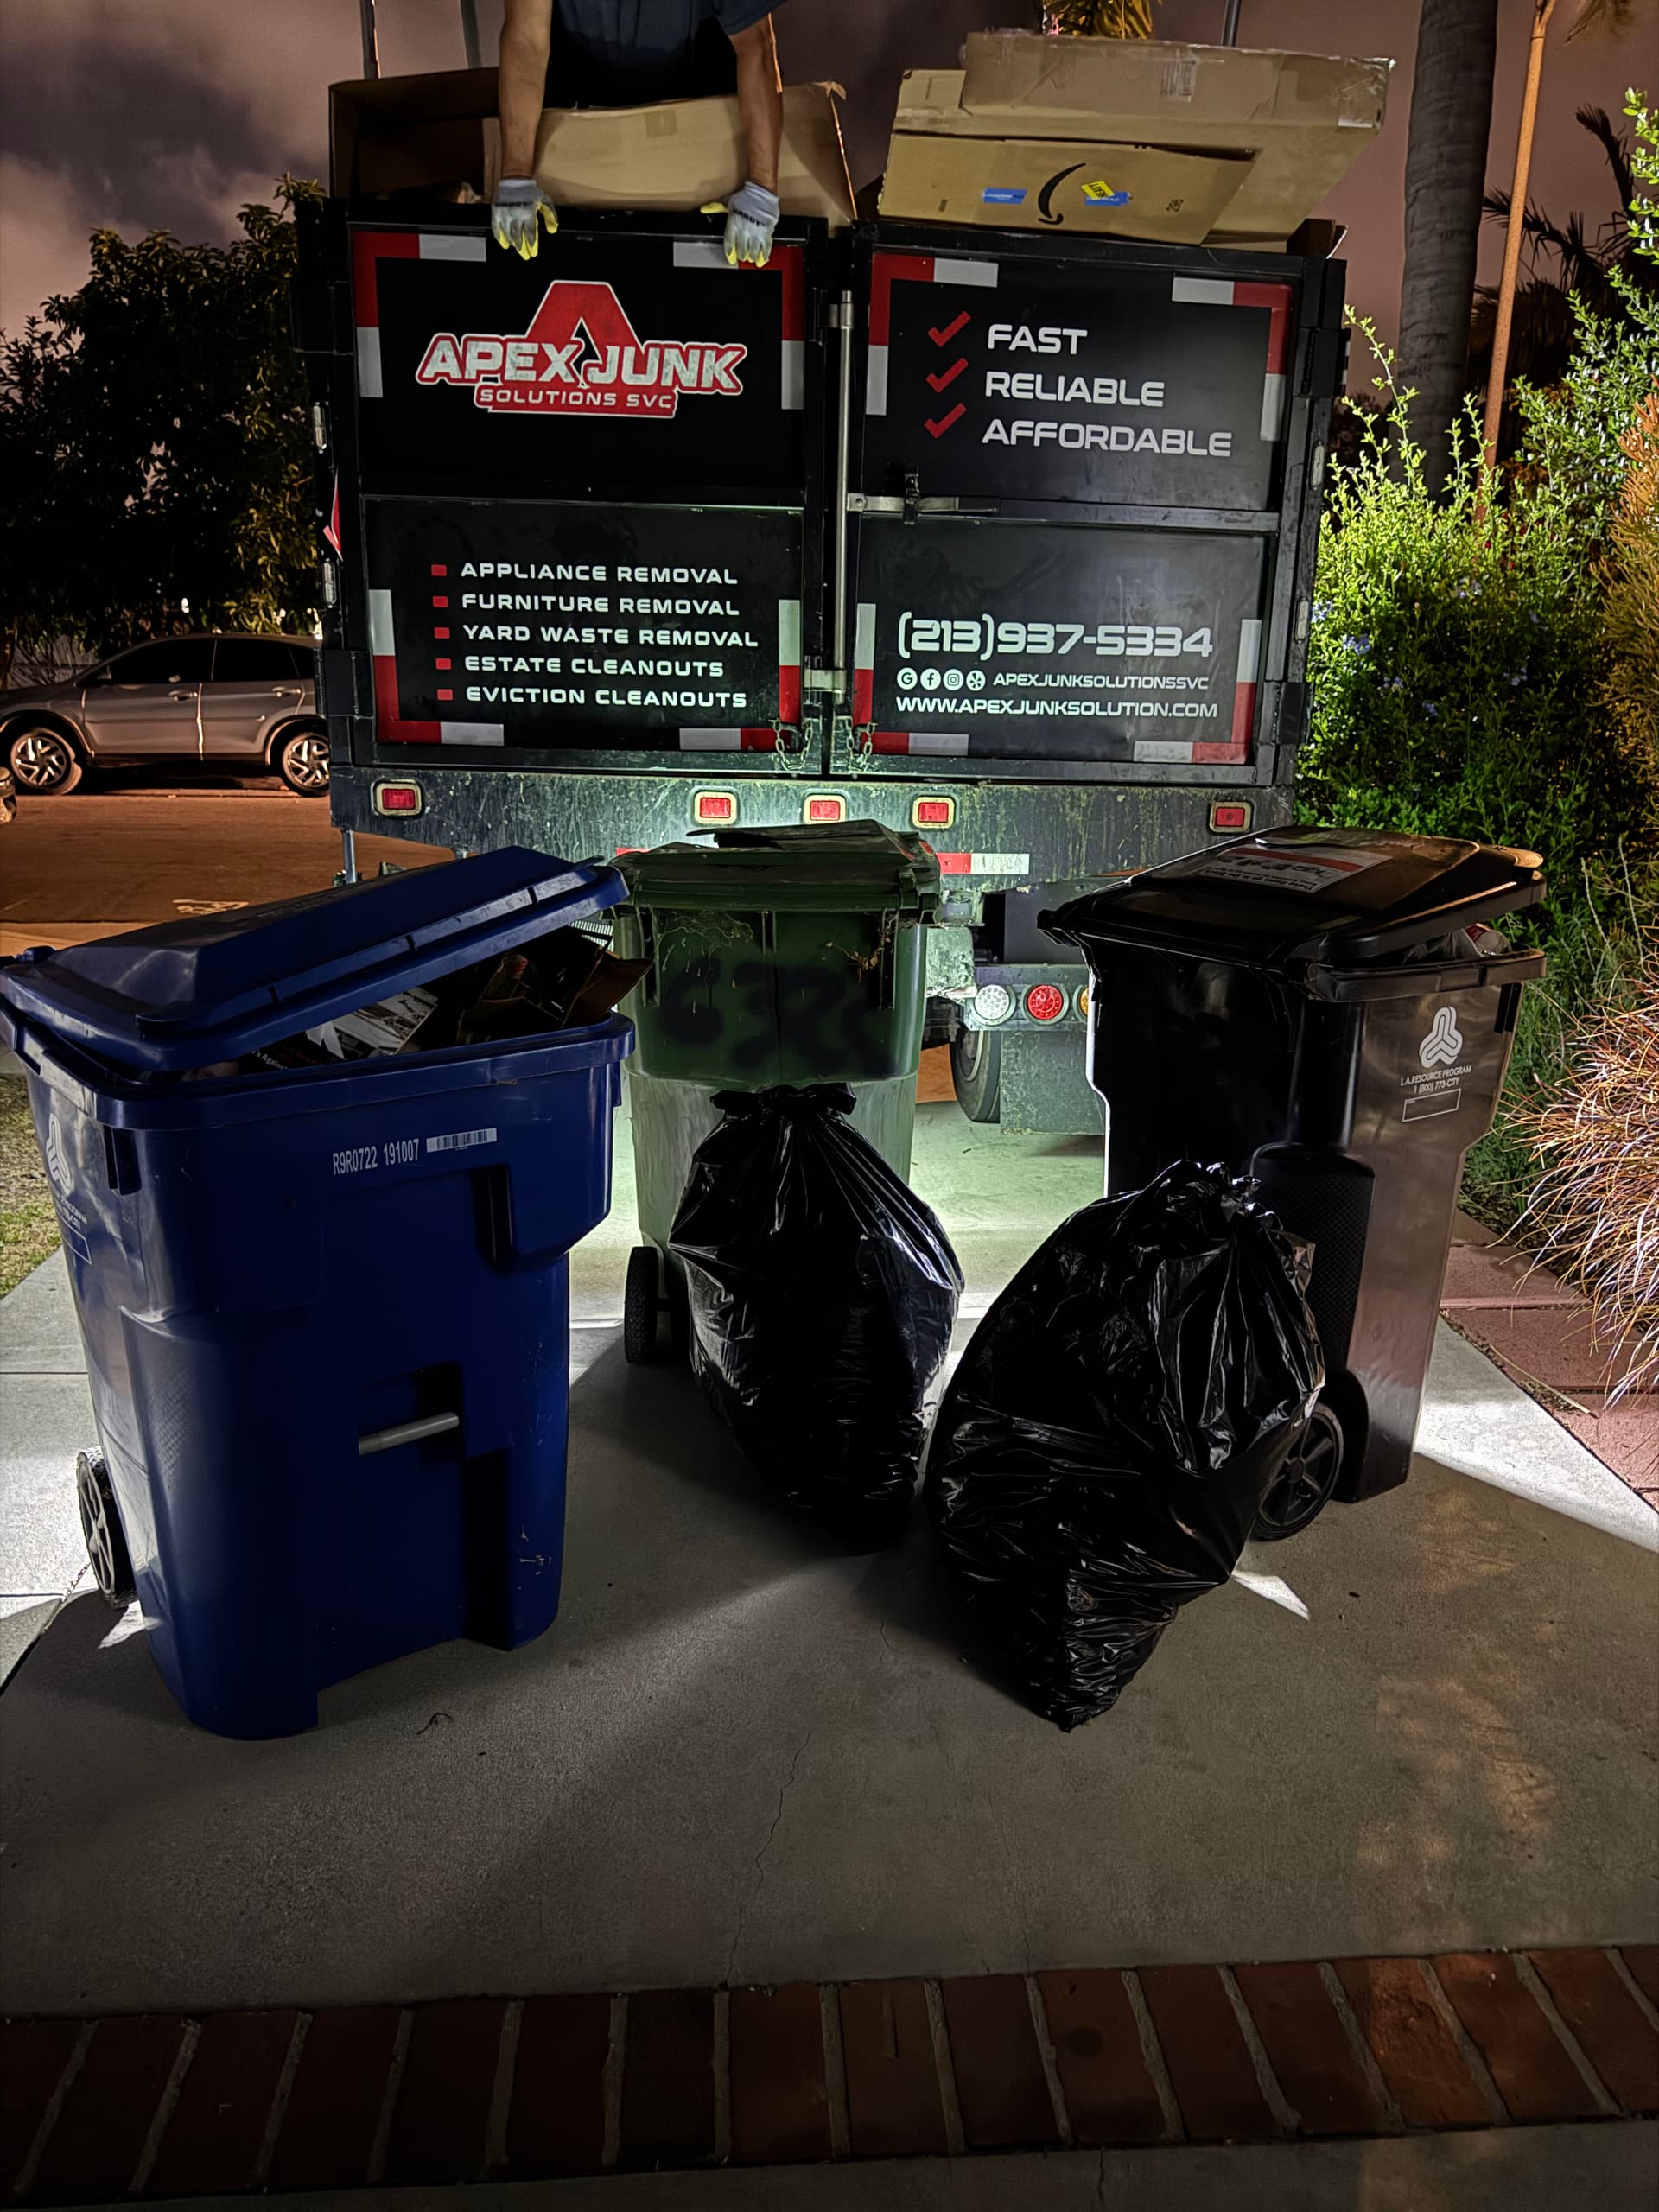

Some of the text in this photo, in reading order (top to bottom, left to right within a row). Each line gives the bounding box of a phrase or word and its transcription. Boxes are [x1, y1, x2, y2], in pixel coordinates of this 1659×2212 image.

[987, 323, 1089, 355] FAST
[419, 338, 746, 391] APEX JUNK
[480, 389, 674, 410] SOLUTIONS SVC
[985, 371, 1166, 407] RELIABLE
[981, 418, 1233, 457] AFFORDABLE
[461, 562, 738, 585] APPLIANCE REMOVAL
[461, 594, 740, 616] FURNITURE REMOVAL
[462, 624, 759, 647] YARD WASTE REMOVAL
[898, 611, 1213, 661] (213)937-5334
[464, 655, 724, 677] ESTATE CLEANOUTS
[993, 672, 1210, 690] APEXJUNKSOLUTIONSSVC
[466, 686, 747, 708] EVICTION CLEANOUTS
[896, 696, 1218, 718] WWW.APEXJUNKSOLUTION.COM
[1442, 1065, 1472, 1078] PROGRAM
[333, 1138, 420, 1176] R9R0722 191007
